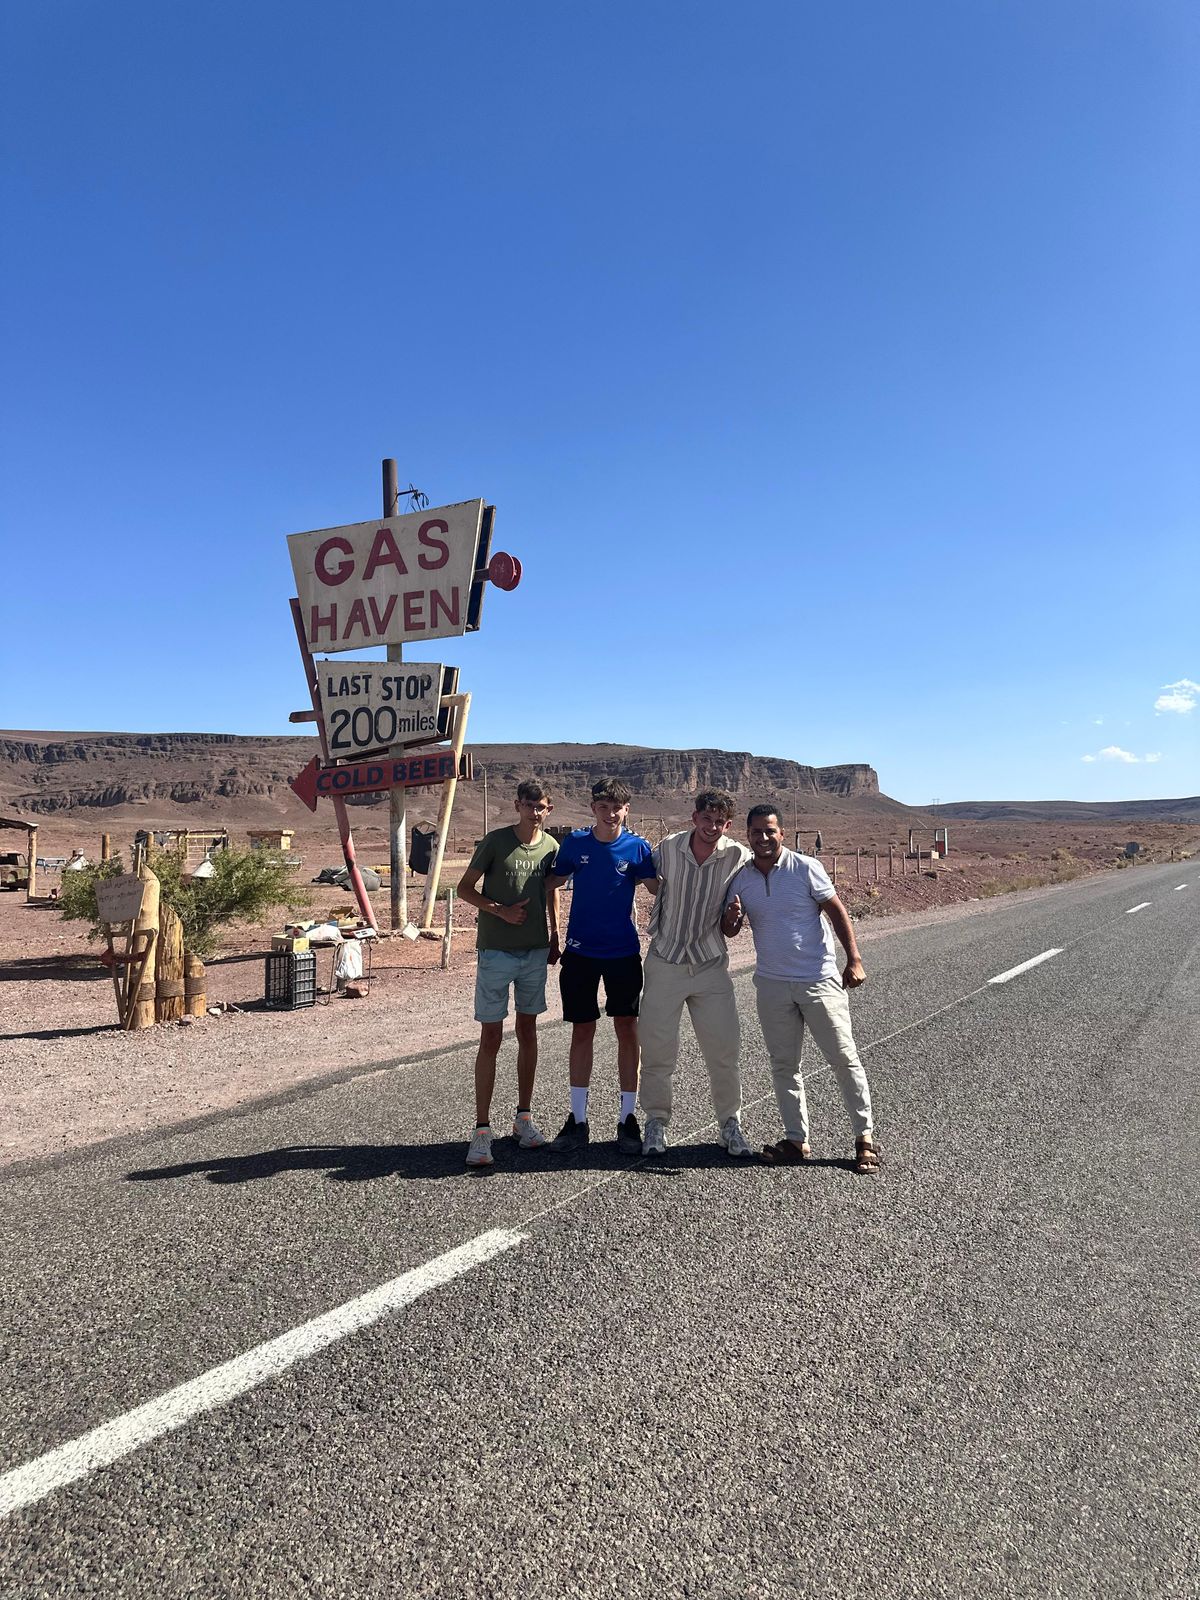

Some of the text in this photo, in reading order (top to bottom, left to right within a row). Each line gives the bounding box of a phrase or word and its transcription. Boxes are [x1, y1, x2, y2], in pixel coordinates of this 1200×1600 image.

[314, 518, 450, 586] GAS
[310, 586, 460, 643] HAVEN
[327, 674, 432, 701] LAST STOP
[330, 706, 435, 749] 200 miles
[316, 756, 454, 791] COLD BEER
